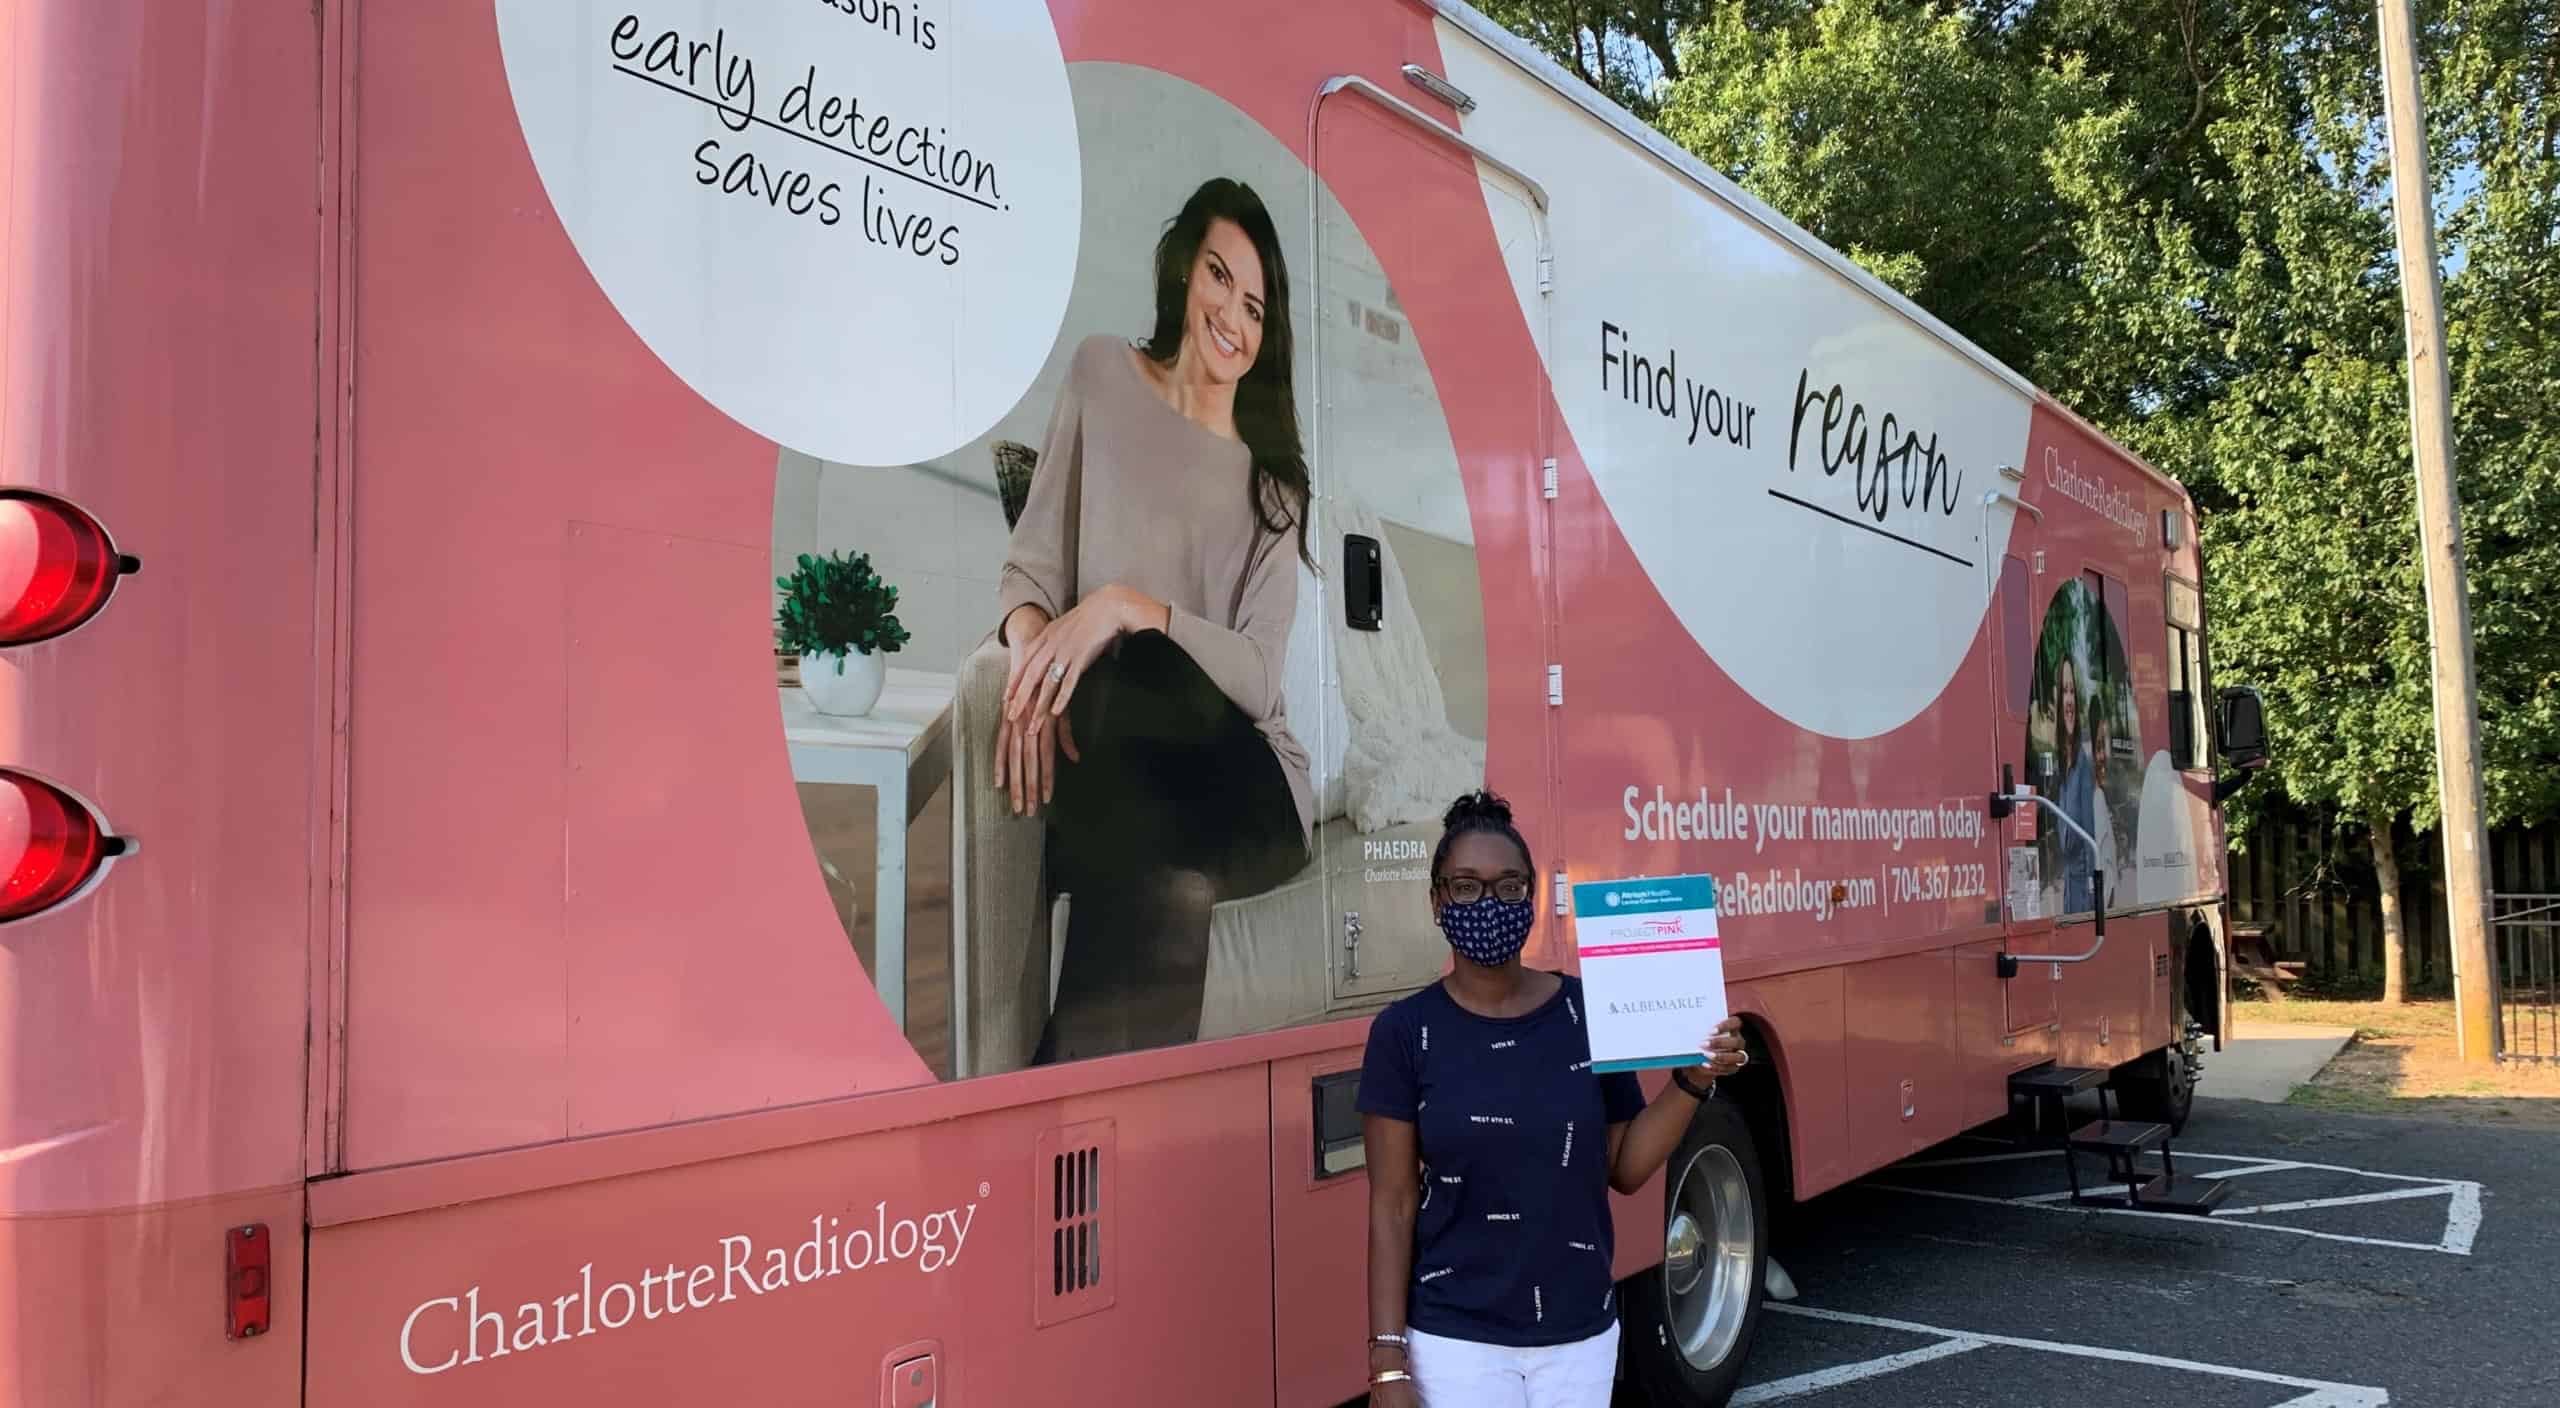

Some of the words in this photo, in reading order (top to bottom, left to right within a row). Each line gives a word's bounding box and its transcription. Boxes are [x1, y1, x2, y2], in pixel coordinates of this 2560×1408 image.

[913, 3, 936, 50] is
[610, 14, 755, 131] early
[695, 140, 841, 225] saves
[863, 175, 960, 265] lives
[1601, 320, 1676, 418] Find
[1687, 377, 1756, 448] your
[1364, 841, 1428, 860] PHAEDRA
[1623, 785, 1748, 841] Schedule
[1753, 804, 1806, 853] your
[1812, 804, 1936, 851] mammogram
[1938, 799, 1986, 848] today.
[1889, 863, 1987, 905] 704.367.2232
